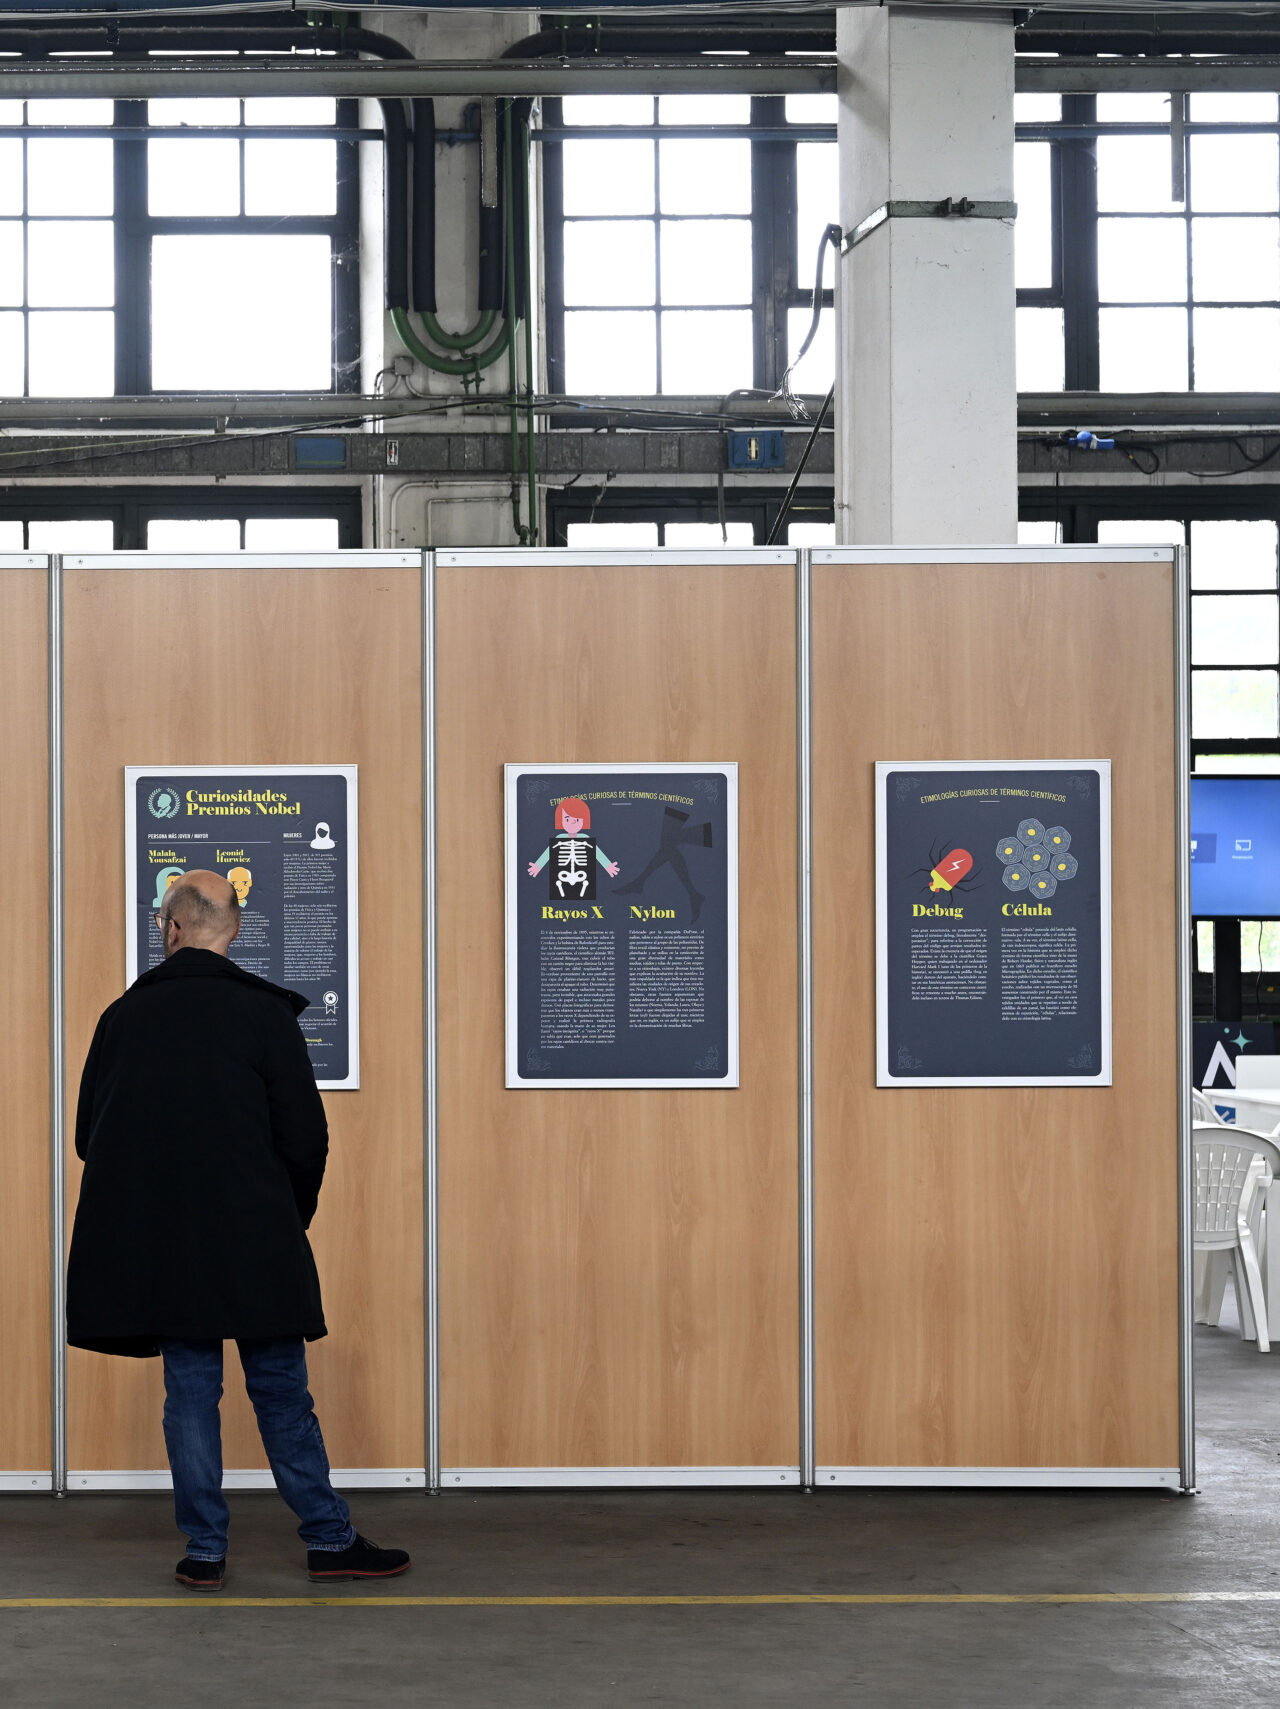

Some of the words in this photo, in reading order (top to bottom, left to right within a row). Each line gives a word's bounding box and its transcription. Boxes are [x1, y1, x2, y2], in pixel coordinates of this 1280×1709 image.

[185, 789, 287, 802] Curiosidades
[588, 791, 618, 800] CURIOSAS
[628, 790, 658, 800] TÉRMINOS
[658, 793, 694, 806] CIENTÍFICOS
[920, 790, 959, 804] ETIMOLOGÍAS
[959, 788, 989, 797] CURIOSAS
[990, 788, 998, 796] DE
[999, 787, 1029, 797] TÉRMINOS
[1030, 790, 1067, 803] CIENTÍFICOS
[186, 802, 252, 816] Premios
[255, 801, 301, 815] Nobel
[148, 849, 176, 857] Malala
[216, 849, 244, 857] Leonid
[541, 906, 588, 922] Rayos
[591, 906, 605, 919] X
[628, 905, 675, 922] Nylon
[912, 904, 964, 920] Debug
[1001, 903, 1052, 917] Célula
